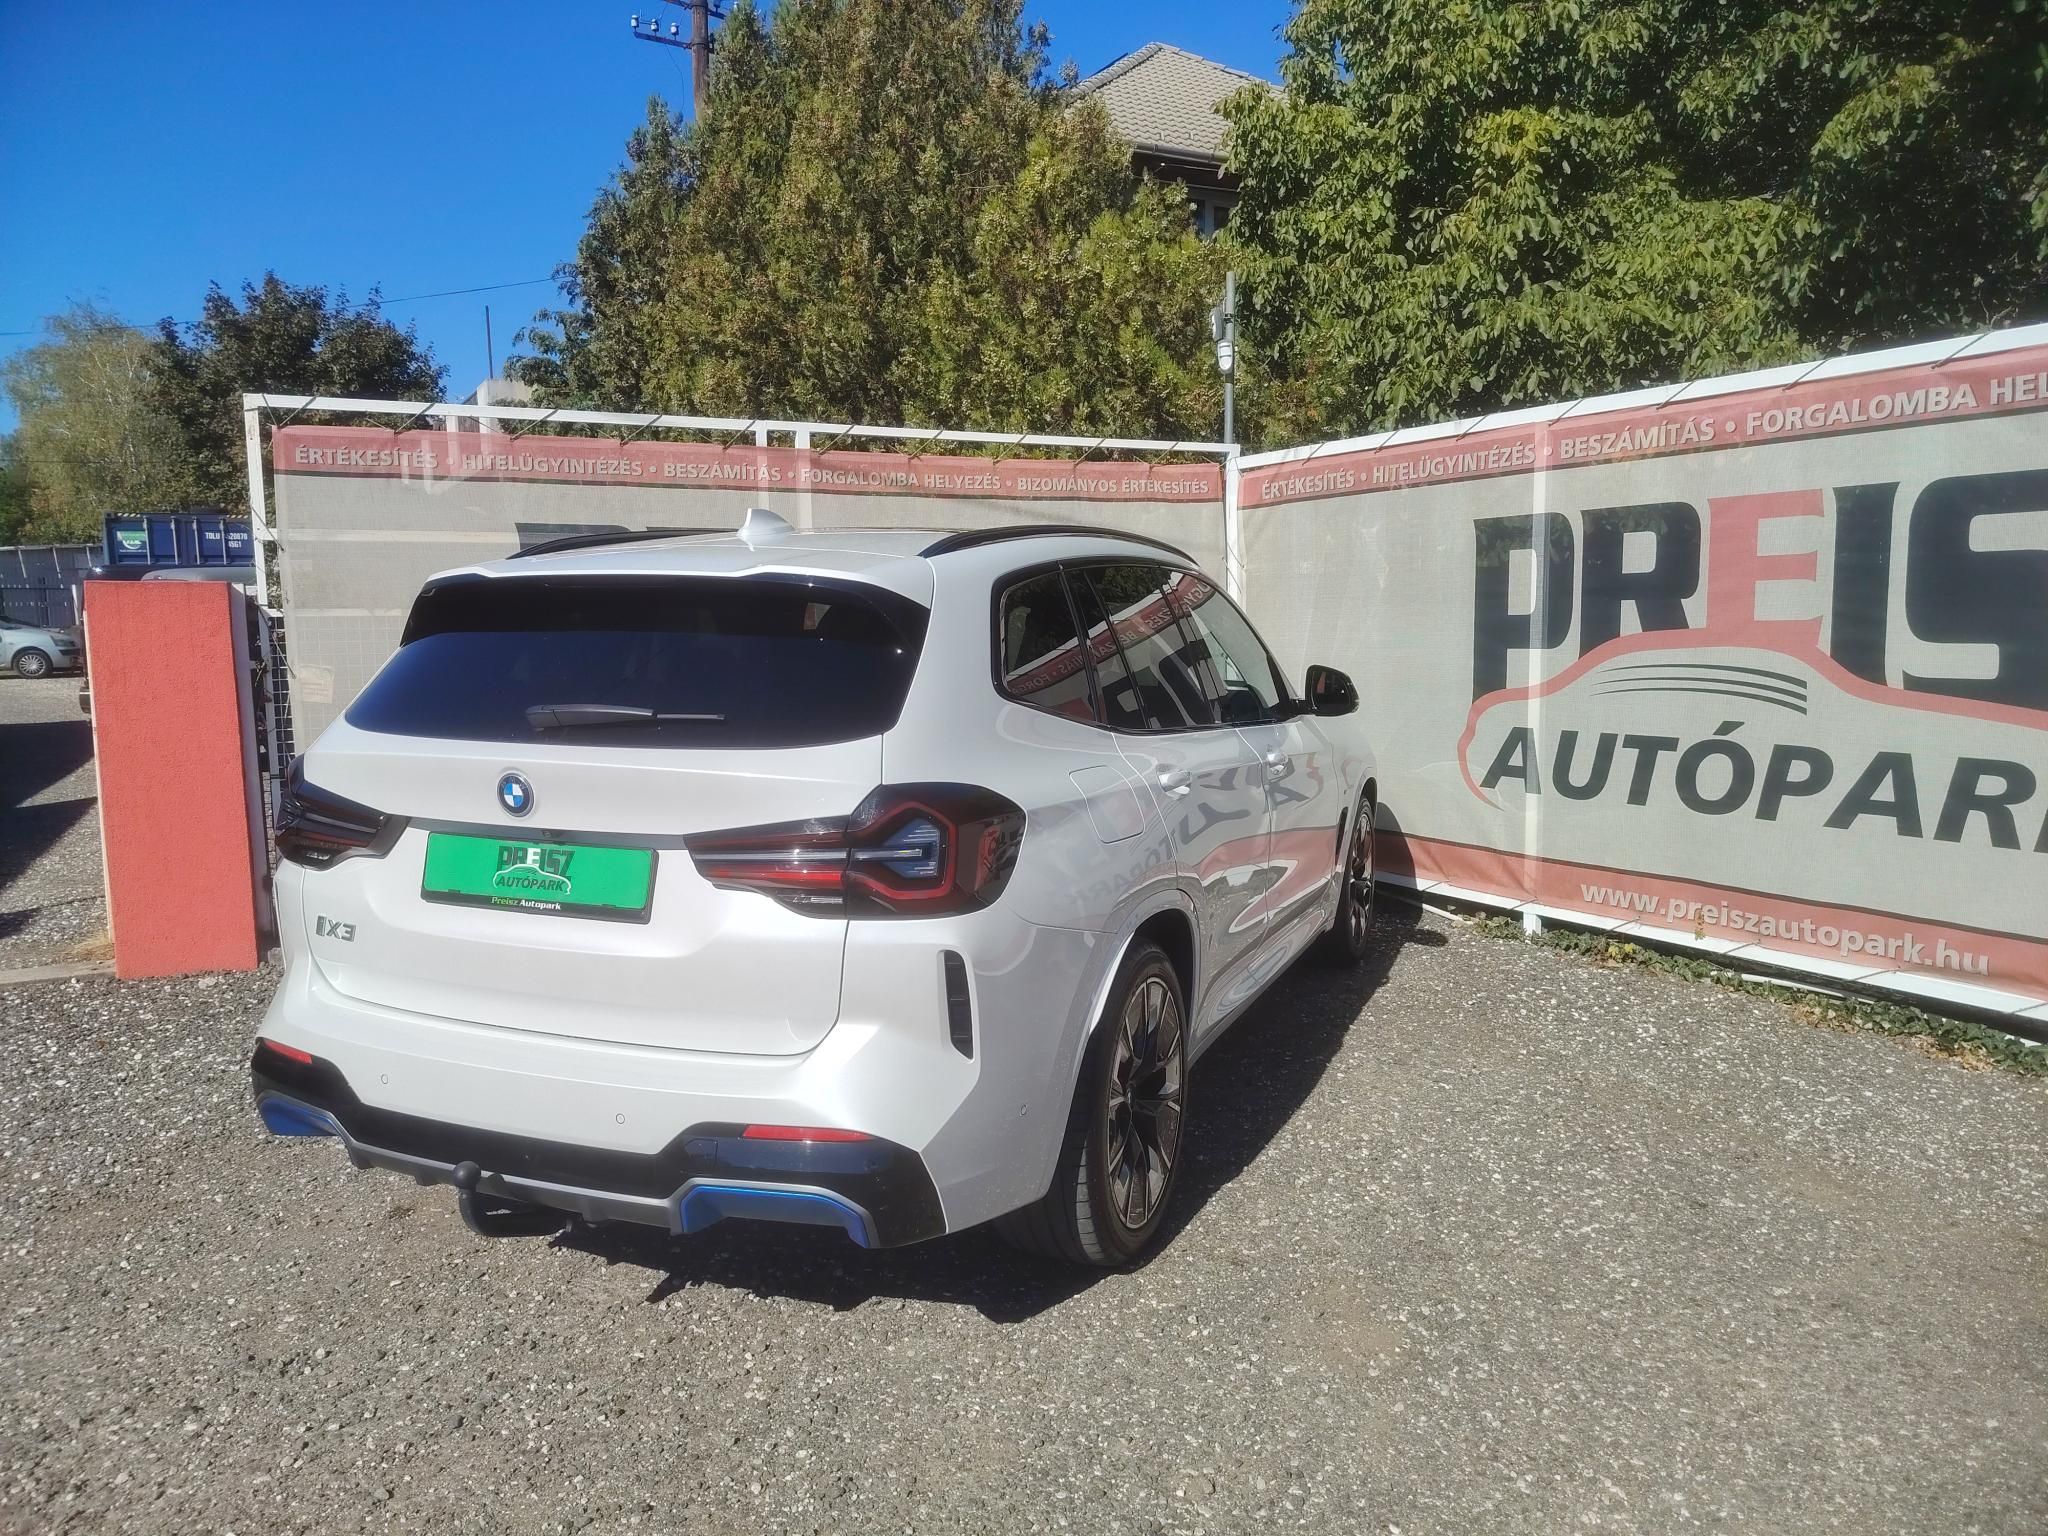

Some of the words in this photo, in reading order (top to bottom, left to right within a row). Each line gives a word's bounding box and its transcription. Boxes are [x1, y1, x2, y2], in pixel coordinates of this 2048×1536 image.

[295, 444, 439, 468] ÉRTÉKESÍTÉS
[462, 453, 643, 477] HITELÜGYINTÉZÉS
[663, 460, 782, 481] BESZÁMÍTÁS
[800, 467, 920, 487] FORGALOMBA
[924, 470, 1001, 490] HELYEZÉS
[1017, 475, 1118, 493] BIZOMÁNYOS
[1122, 476, 1210, 495] ÉRTÉKESÍTÉS
[1261, 468, 1355, 501] ÉRTÉKESÍTÉS
[1371, 439, 1537, 485] HITELÜGYINTÉZÉS
[1559, 416, 1716, 460] BESZÁMÍTÁS
[1746, 383, 1978, 436] FORGALOMBA
[1479, 720, 2048, 853] AUTÓPAR
[491, 896, 519, 906] Preisz
[519, 899, 562, 911] Autopark
[496, 875, 564, 892] AUTÓPARK
[1579, 881, 1991, 976] www.preiszautopark.hu
